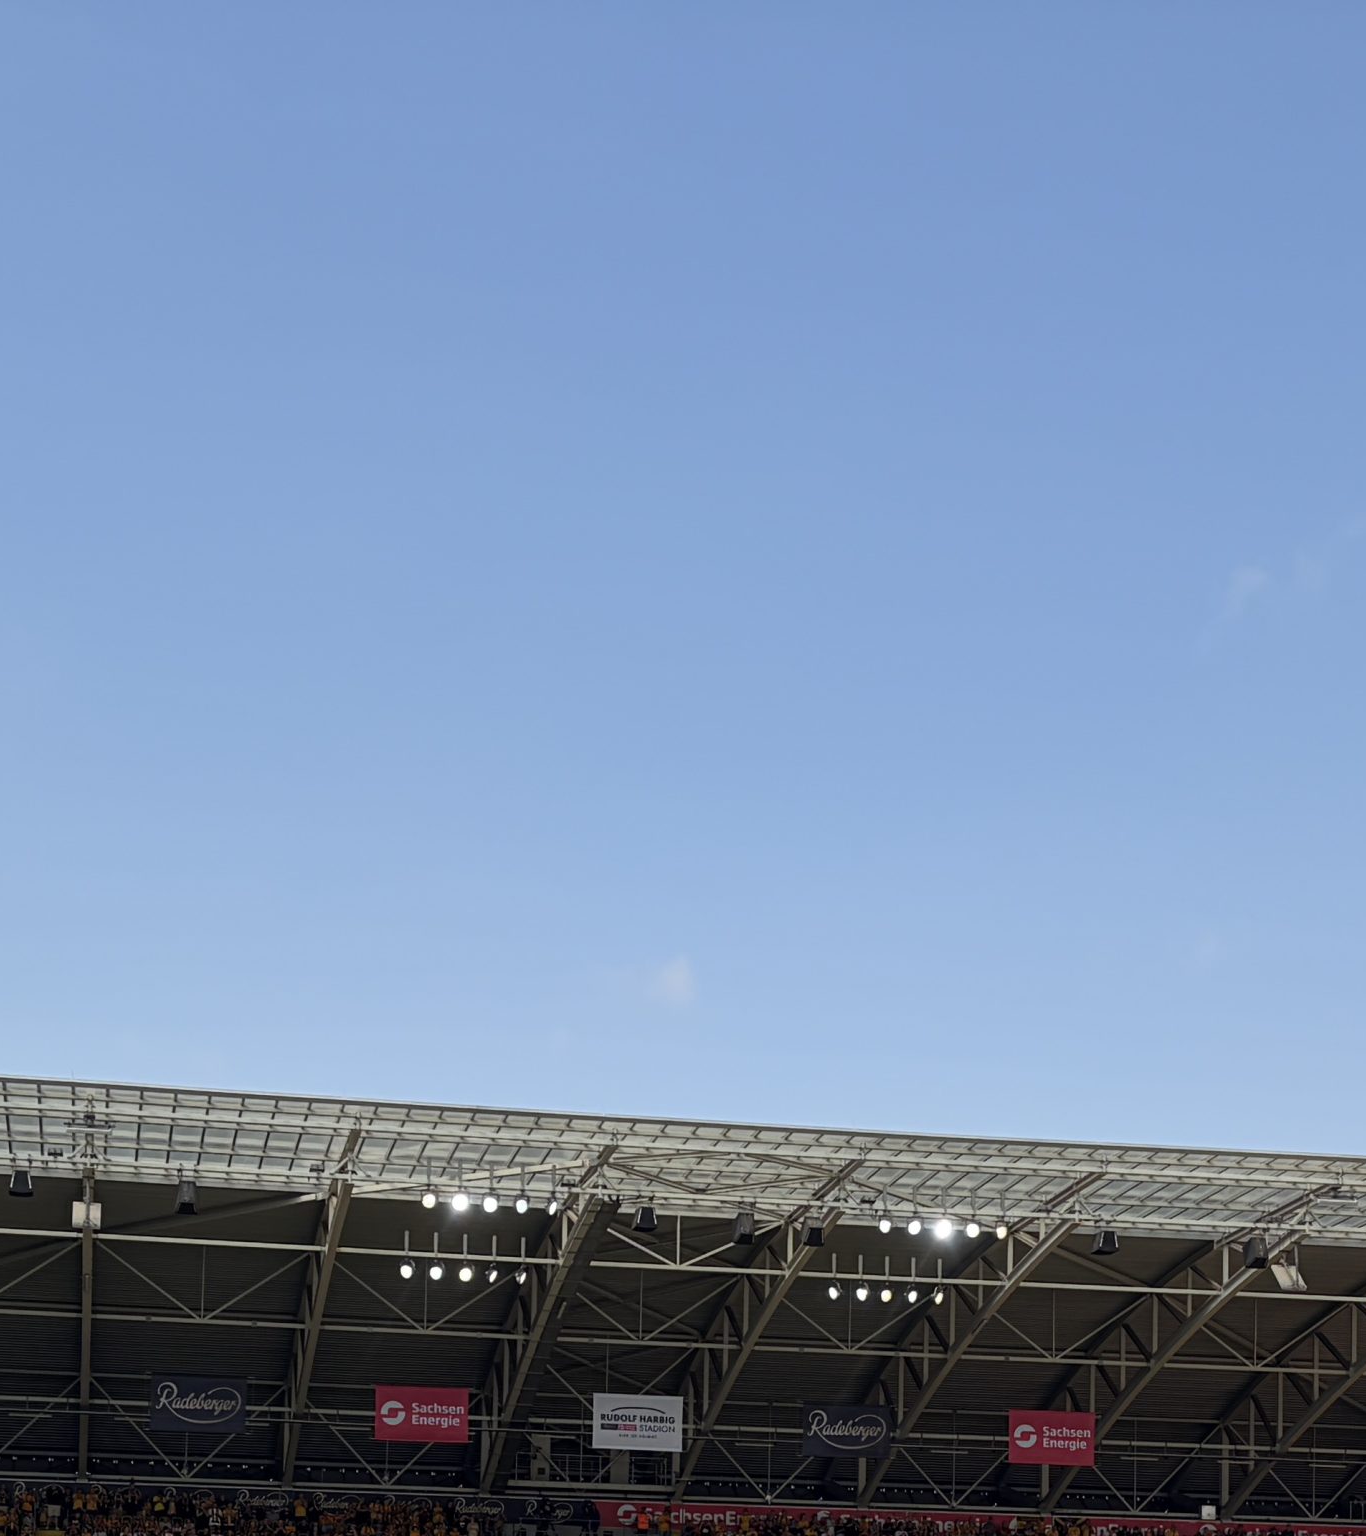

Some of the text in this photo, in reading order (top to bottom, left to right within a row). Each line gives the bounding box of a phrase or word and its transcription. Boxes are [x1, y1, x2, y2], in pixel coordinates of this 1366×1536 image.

[156, 1381, 241, 1424] Radeberger
[411, 1402, 464, 1415] Sachsen
[411, 1414, 460, 1428] Energie
[600, 1413, 676, 1425] RUDOLF HARBIG
[639, 1425, 676, 1433] STADION
[807, 1410, 886, 1449] Radeberger
[1042, 1426, 1092, 1439] Sachsen
[1042, 1438, 1087, 1451] Energie
